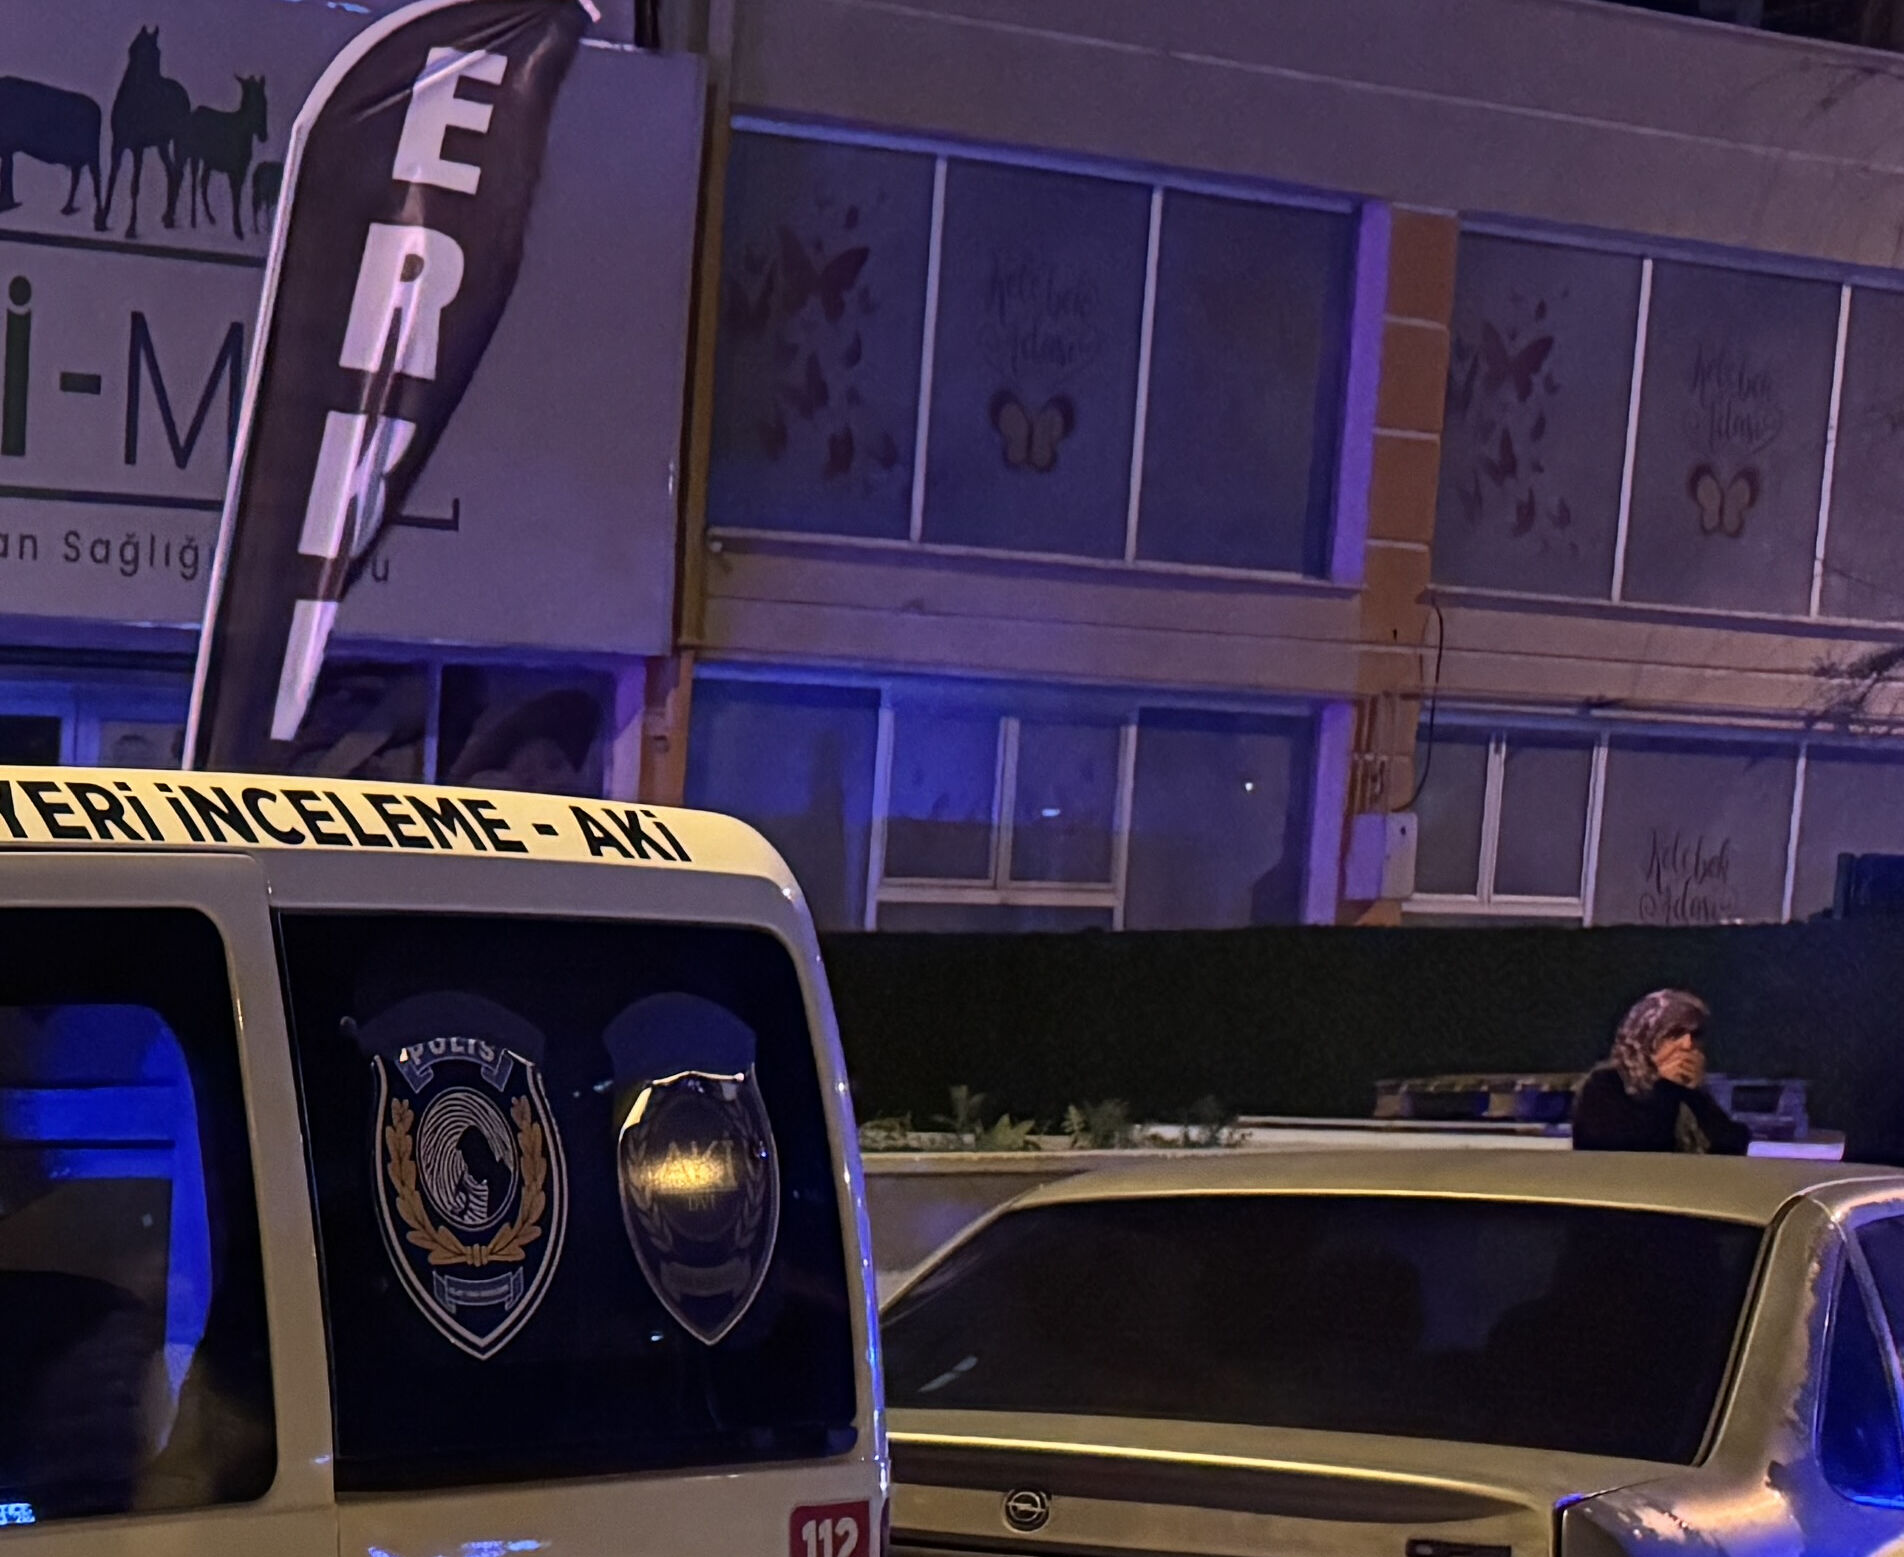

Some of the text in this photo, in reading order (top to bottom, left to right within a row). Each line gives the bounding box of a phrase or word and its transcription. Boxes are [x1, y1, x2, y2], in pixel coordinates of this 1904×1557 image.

[62, 529, 200, 581] Sağlığ
[164, 783, 529, 854] İNCELEME
[568, 805, 693, 862] AKİ
